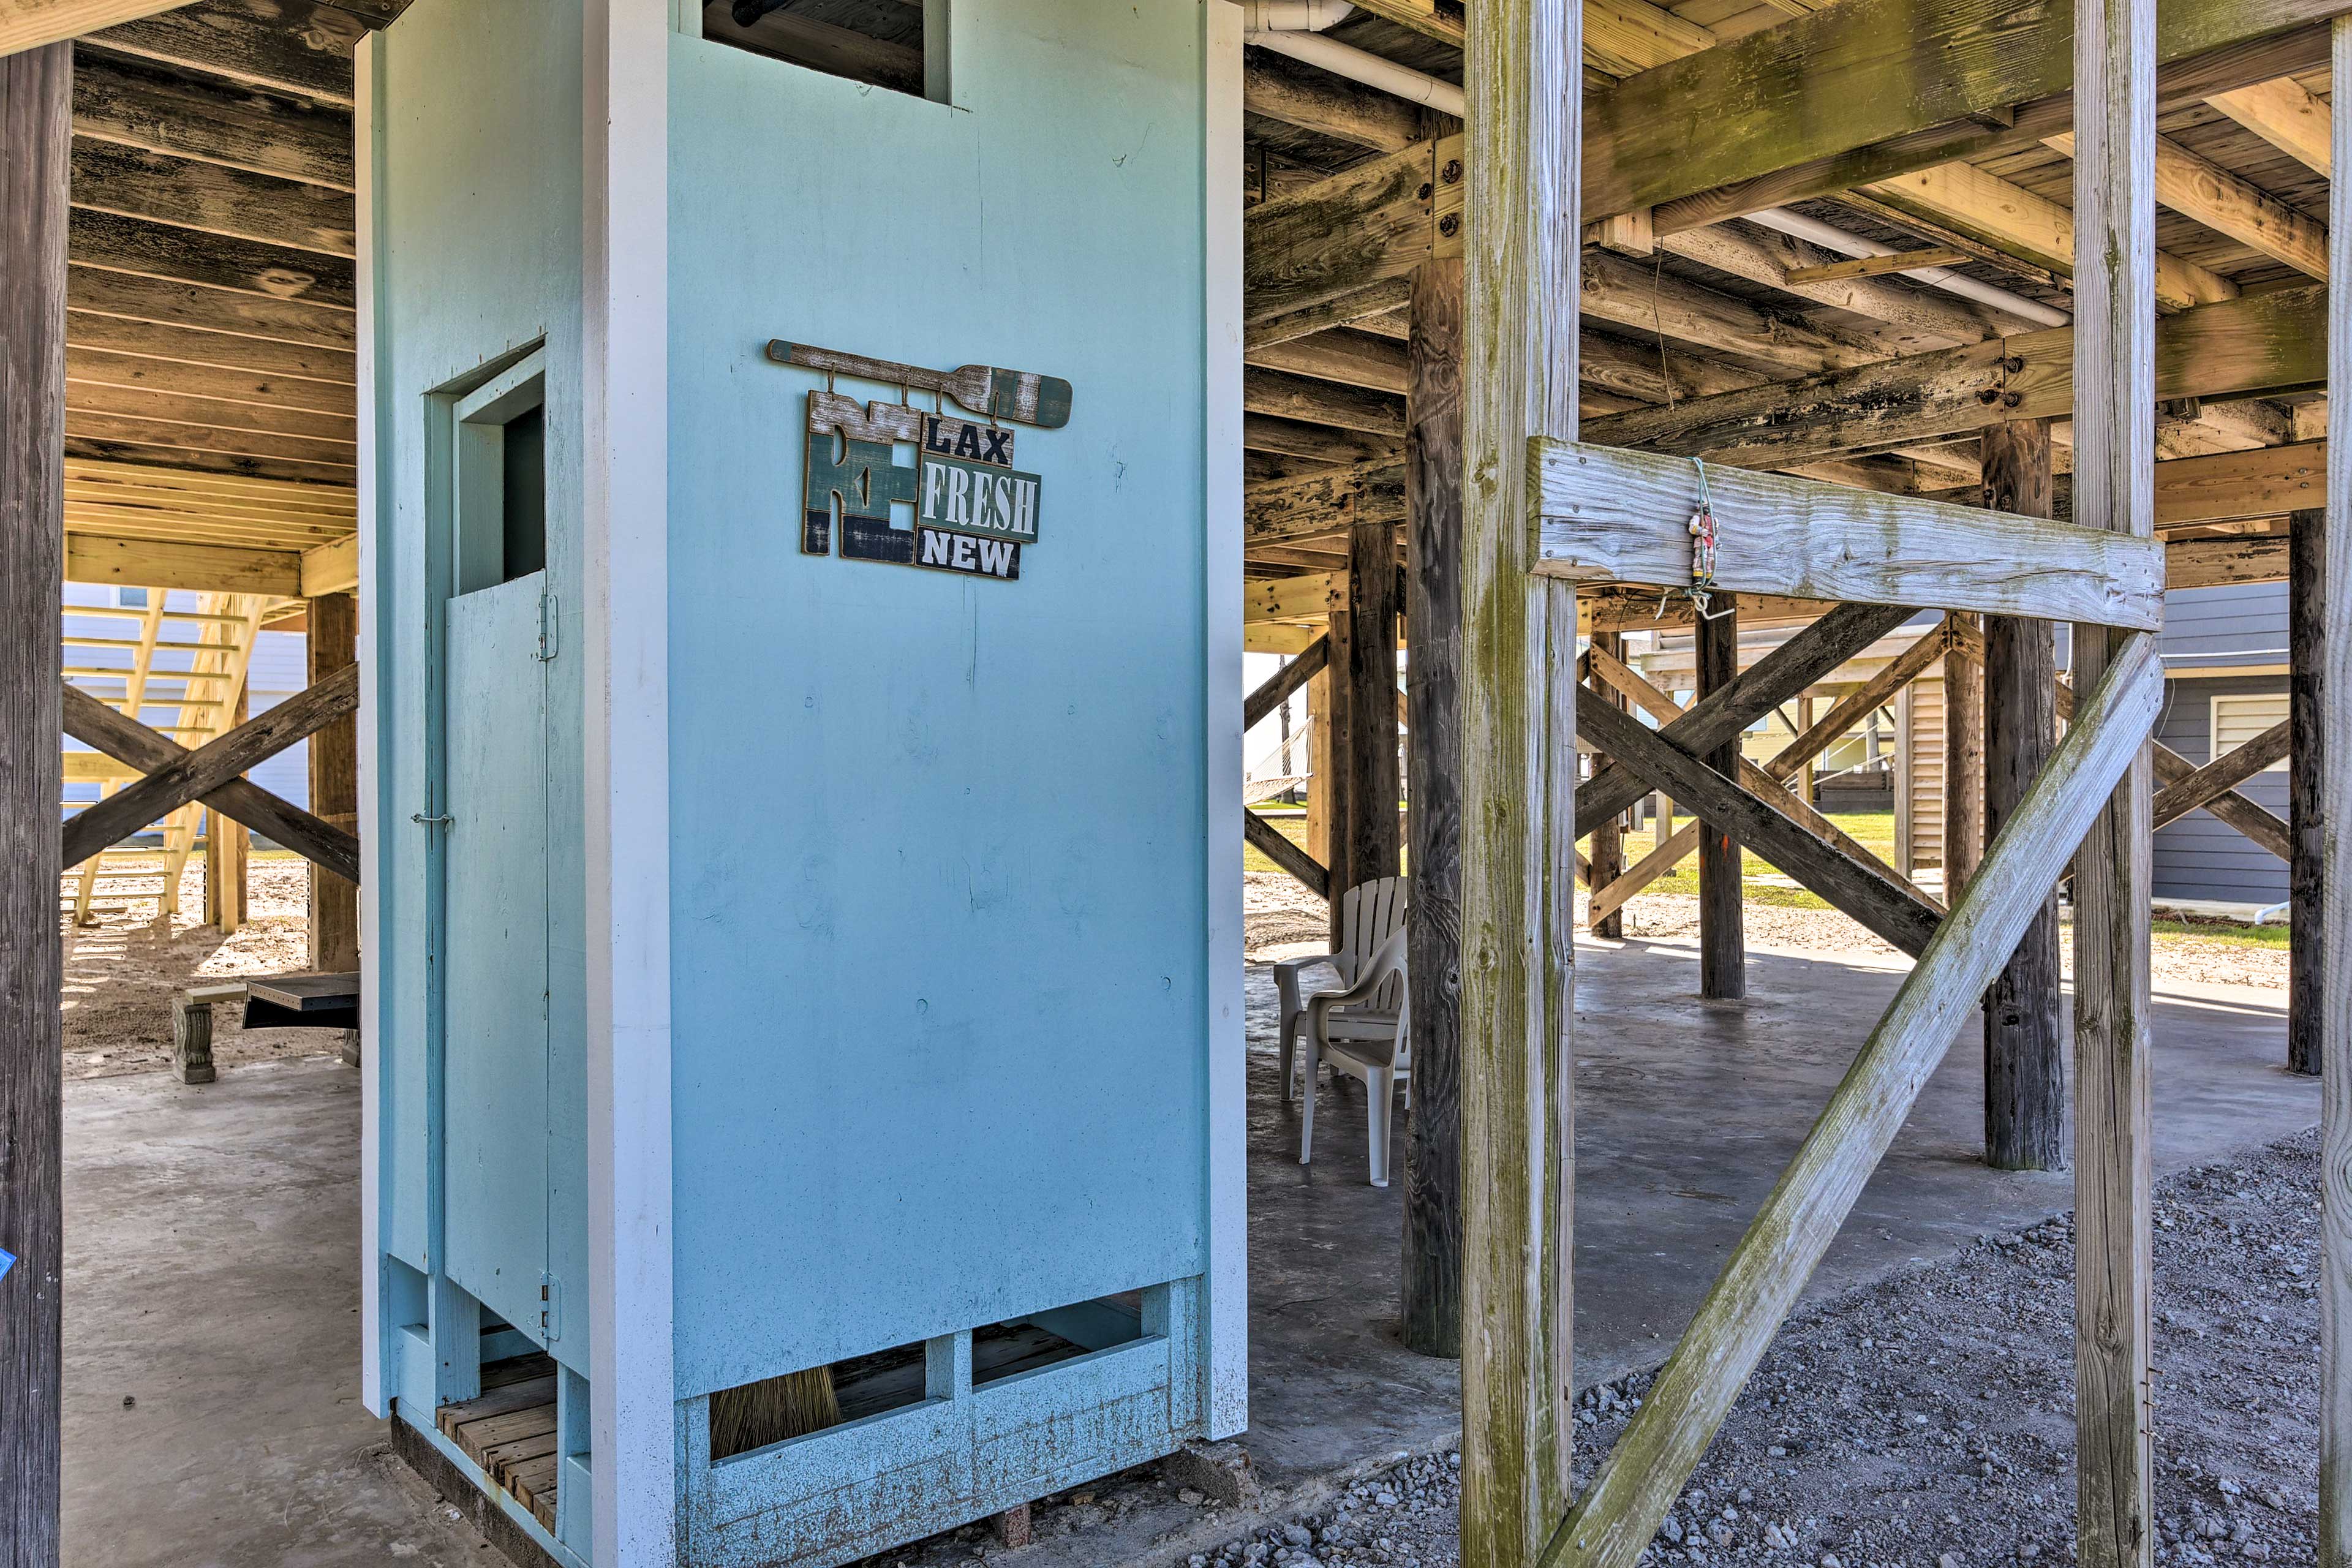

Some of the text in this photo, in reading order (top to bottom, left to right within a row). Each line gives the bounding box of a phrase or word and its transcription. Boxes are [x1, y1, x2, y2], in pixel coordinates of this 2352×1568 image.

[927, 418, 1009, 463] LAX
[923, 462, 1037, 535] FRESH
[922, 530, 1014, 577] NEW
